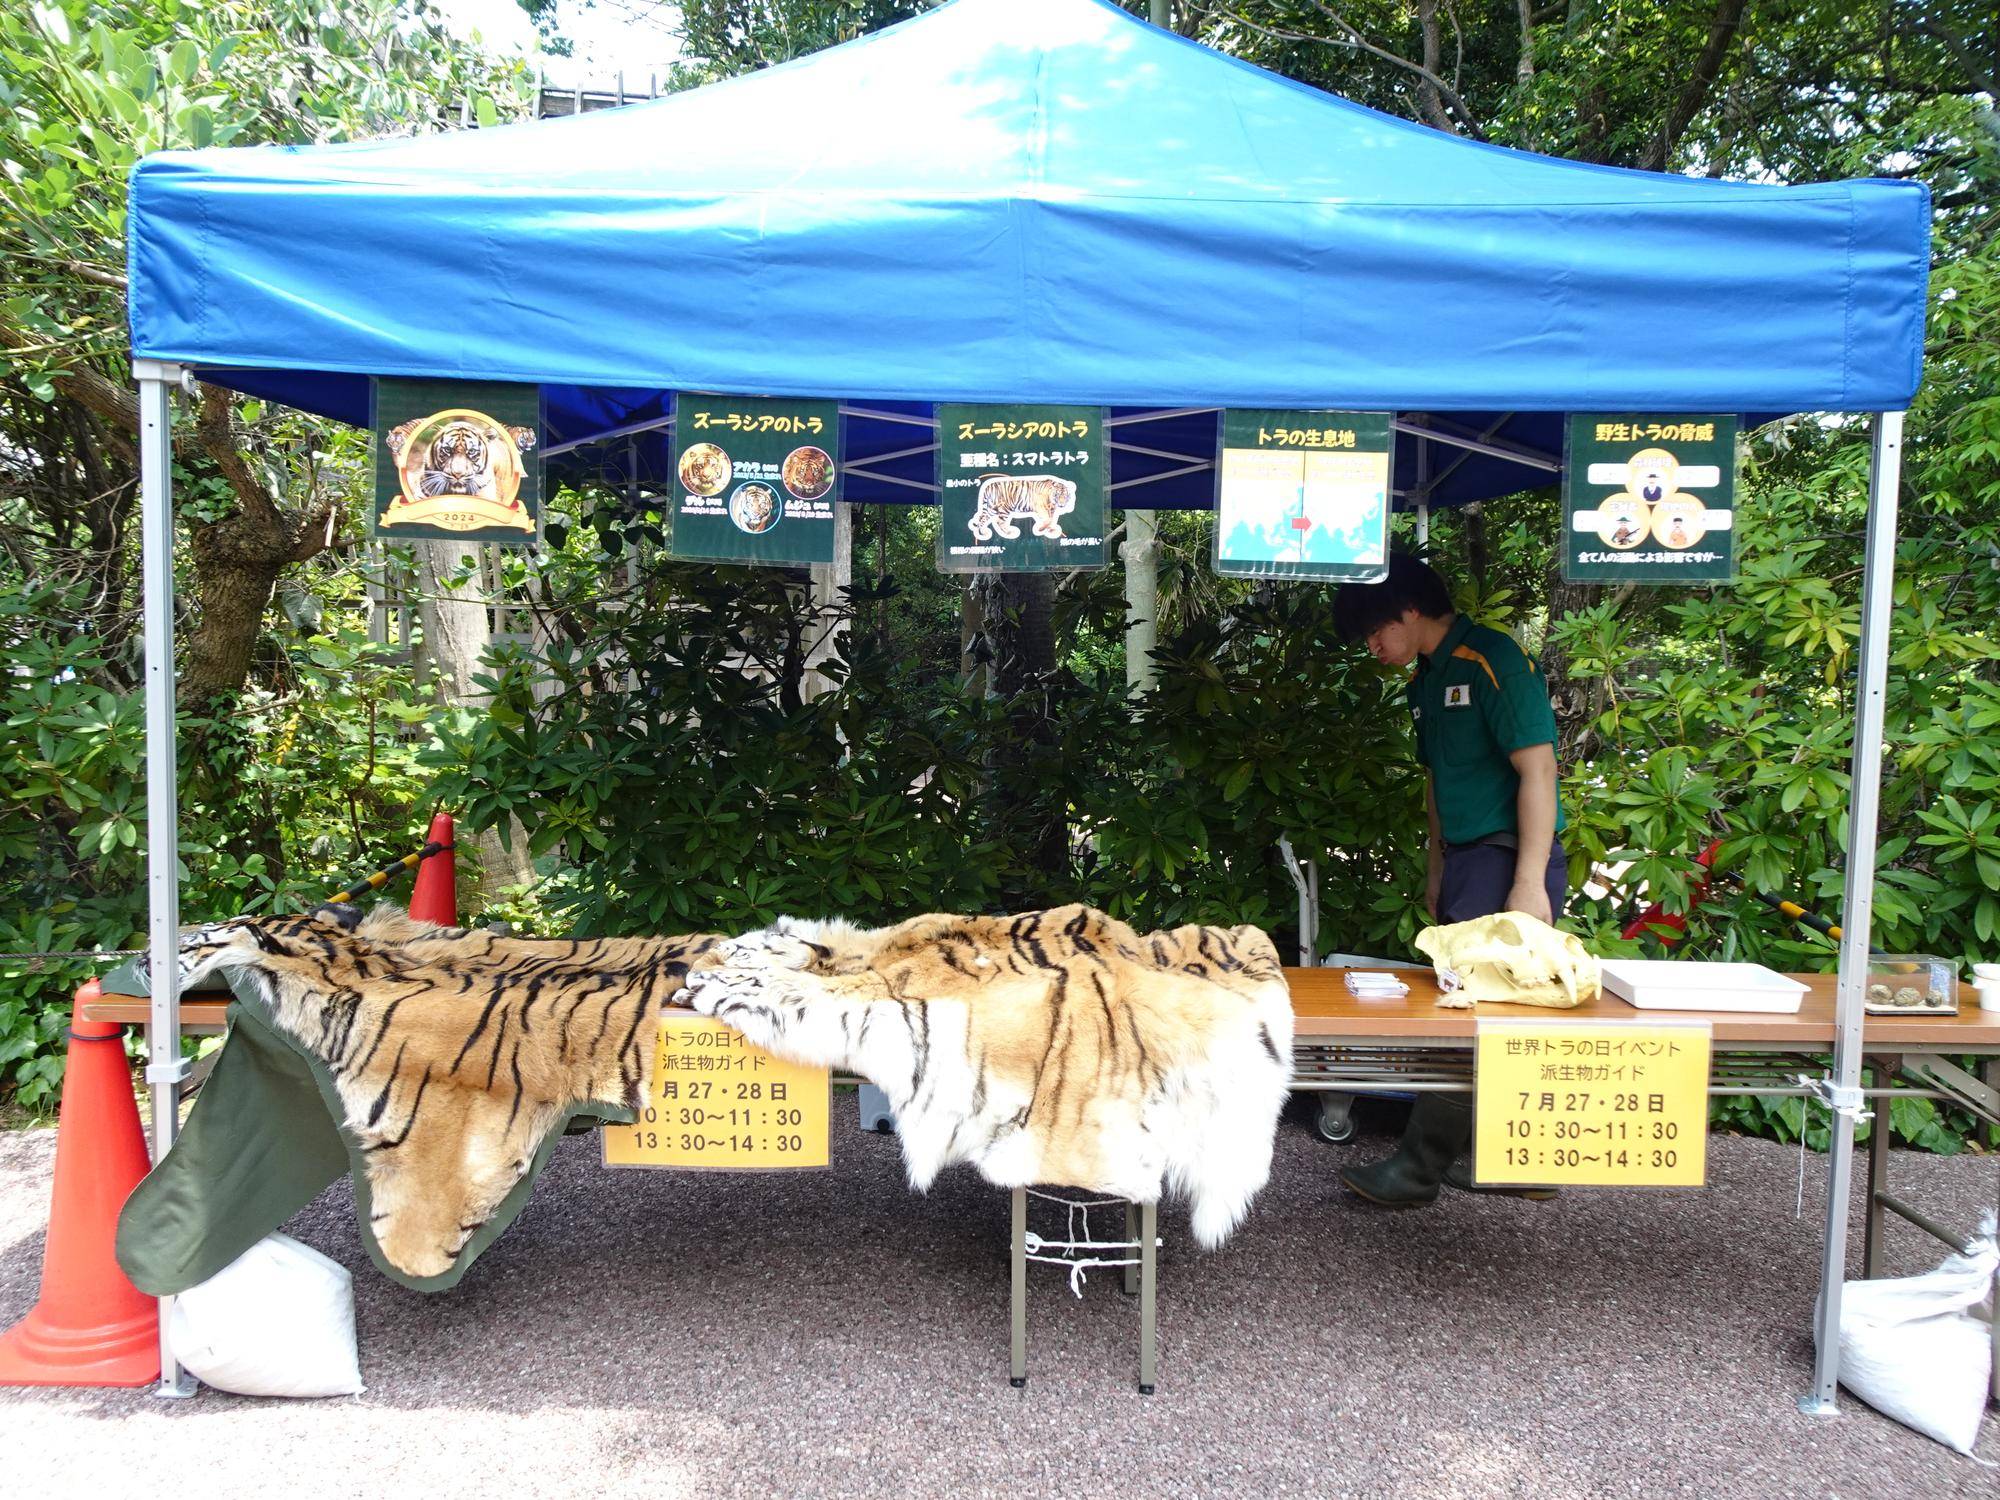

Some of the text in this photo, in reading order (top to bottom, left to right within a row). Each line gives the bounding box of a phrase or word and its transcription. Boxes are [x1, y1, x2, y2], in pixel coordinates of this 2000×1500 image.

[694, 412, 824, 434] ズーラシアのトラ
[959, 421, 1089, 441] ズーラシアのトラ
[1258, 428, 1356, 448] トラの生息地
[1595, 423, 1715, 442] 野生トラの脅威
[444, 513, 475, 522] 2024
[1505, 1039, 1681, 1057] 世界トラの日イベント
[662, 1054, 766, 1071] 派生物ガイド
[1540, 1064, 1645, 1081] 派生物ガイド
